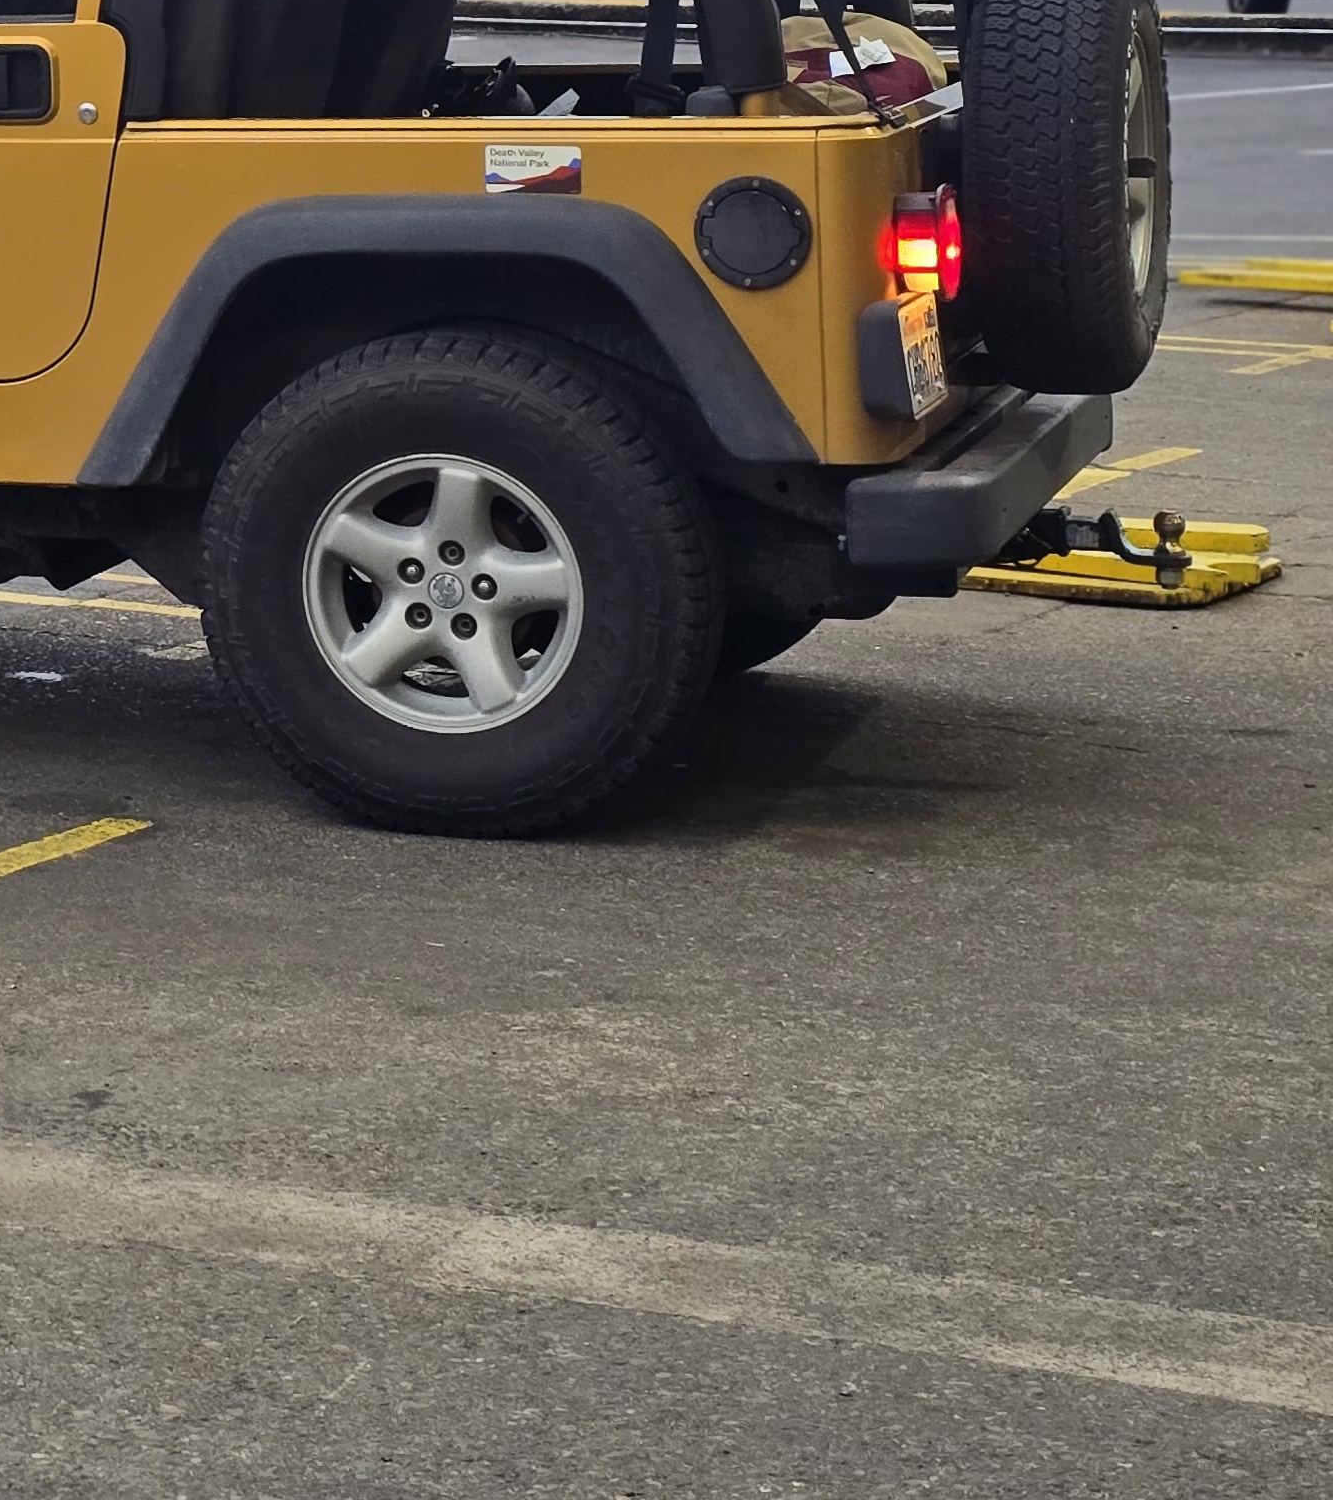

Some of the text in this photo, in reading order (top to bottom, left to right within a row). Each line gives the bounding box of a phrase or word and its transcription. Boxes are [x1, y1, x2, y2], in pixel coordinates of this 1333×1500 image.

[490, 148, 545, 159] Death Valley
[490, 158, 551, 168] National Park
